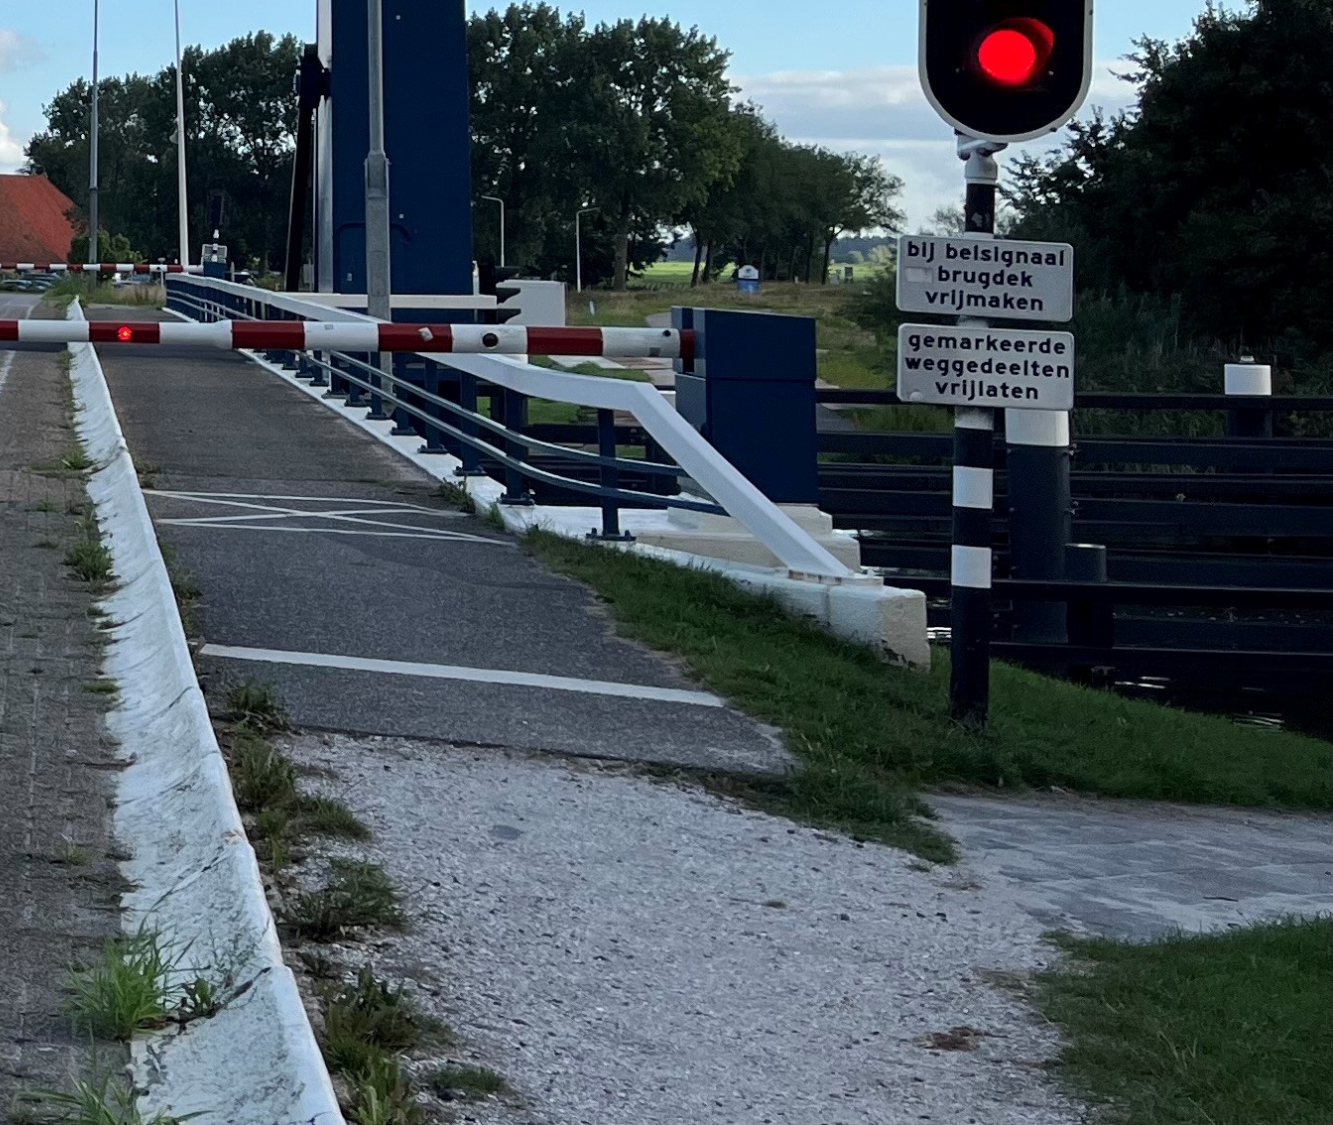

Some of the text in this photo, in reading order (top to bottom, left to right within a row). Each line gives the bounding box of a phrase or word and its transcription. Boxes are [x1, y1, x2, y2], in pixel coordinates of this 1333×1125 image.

[907, 241, 1065, 267] bij belsignaal
[938, 266, 1033, 289] brugdek
[925, 289, 1044, 311] vrijmaken
[908, 334, 1066, 355] gemarkeerde
[905, 357, 1070, 379] weggedeelten
[935, 380, 1039, 401] vrijlaten
